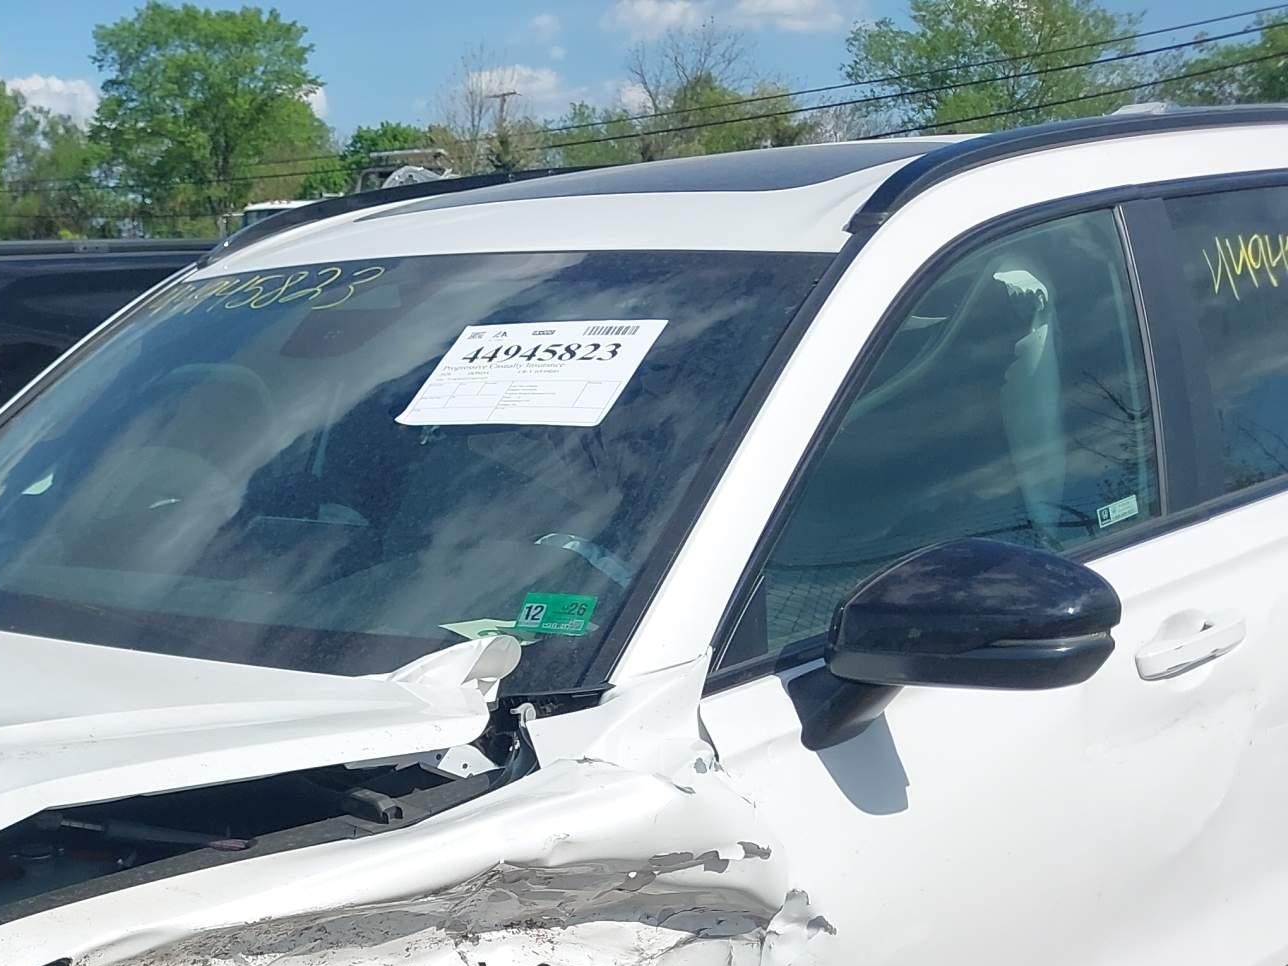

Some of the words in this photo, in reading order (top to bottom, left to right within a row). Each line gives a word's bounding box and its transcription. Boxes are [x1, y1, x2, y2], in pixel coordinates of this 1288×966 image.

[1202, 233, 1288, 301] 4494
[462, 342, 622, 364] 44945823
[524, 604, 545, 621] 12
[567, 602, 588, 616] 26
